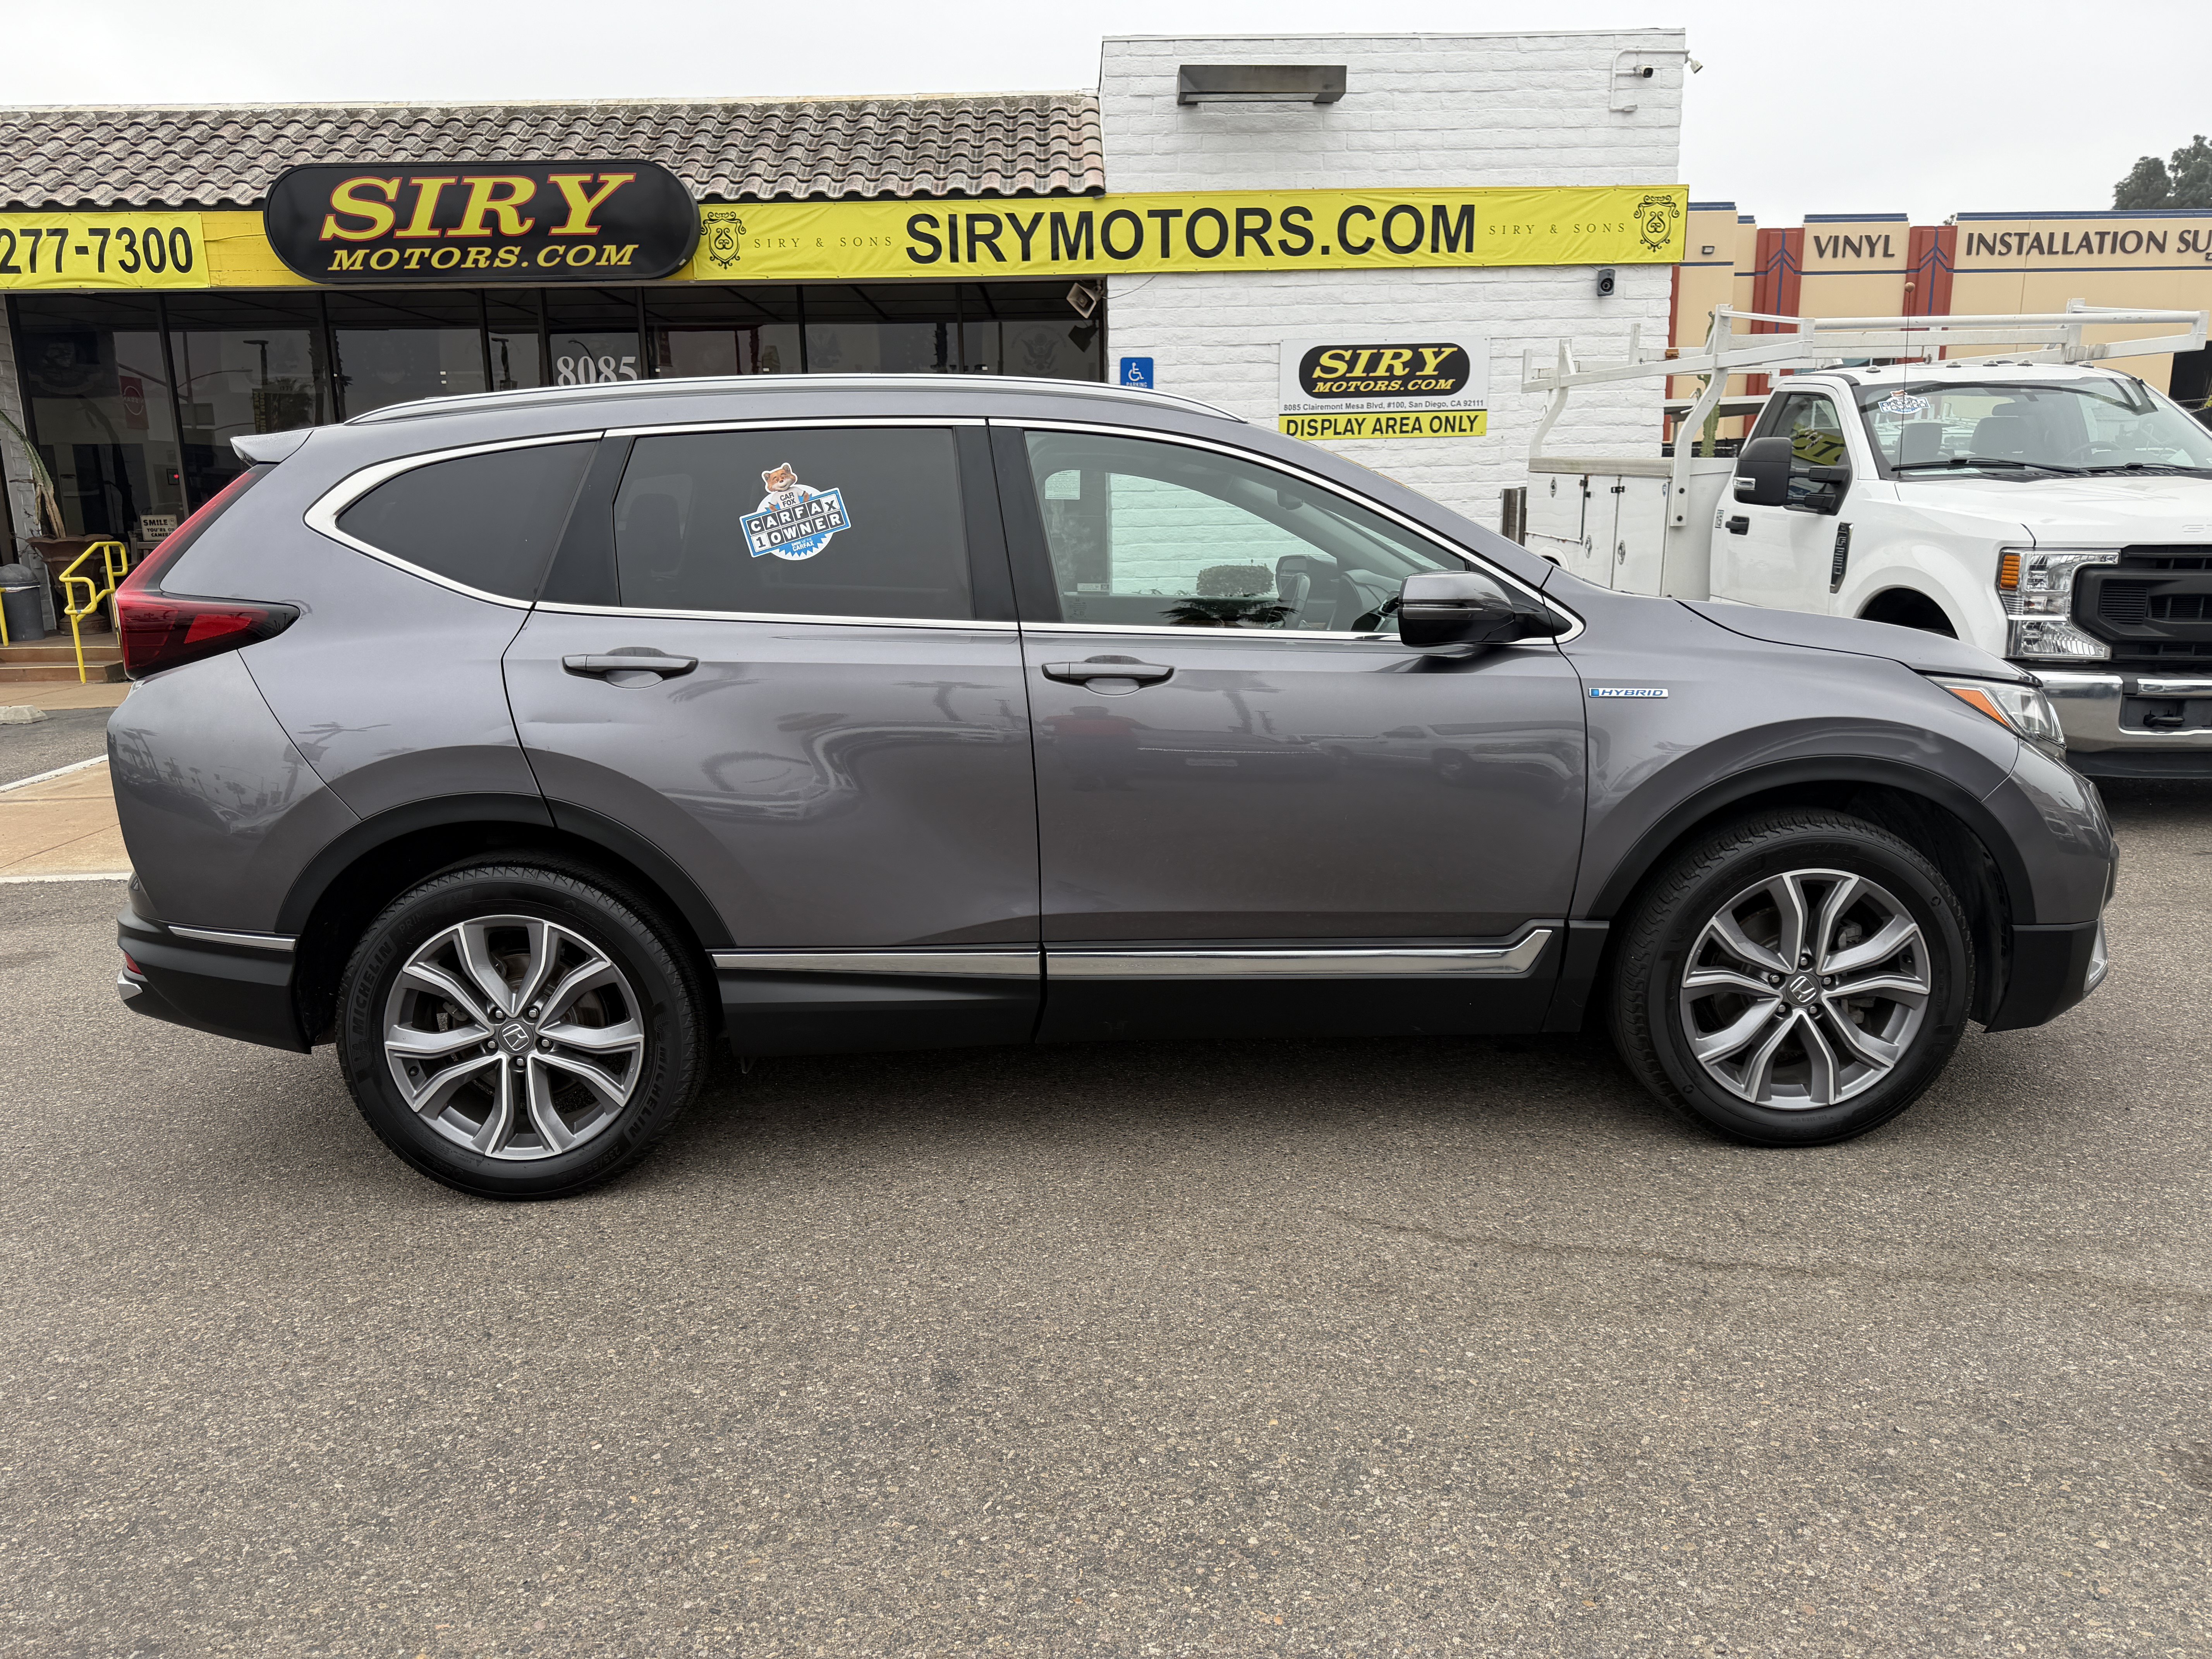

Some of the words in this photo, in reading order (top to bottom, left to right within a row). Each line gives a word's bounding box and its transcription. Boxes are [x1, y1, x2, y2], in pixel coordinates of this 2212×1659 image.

[319, 172, 636, 241] SIRY
[754, 238, 800, 249] SIRY
[816, 238, 824, 248] &
[840, 236, 892, 247] SONS
[906, 204, 1476, 264] SIRYMOTORS.COM
[1489, 224, 1536, 235] SIRY
[1549, 224, 1558, 234] &
[1574, 223, 1625, 233] SONS
[0, 227, 193, 275] 277-7300
[328, 244, 639, 270] MOTORS.COM
[1814, 234, 1895, 258] VINYL
[1966, 230, 2167, 256] INSTALLATION
[557, 356, 637, 386] 8085
[1312, 347, 1458, 378] SIRY
[1312, 379, 1456, 393] MOTORS.COM
[1425, 400, 1448, 409] Diego,
[1287, 418, 1367, 437] DISPLAY
[1371, 416, 1422, 435] AREA
[1429, 415, 1479, 433] ONLY
[780, 492, 795, 501] CAR
[782, 498, 796, 507] FOX
[750, 500, 837, 532] CARFAX
[756, 536, 766, 548] 1
[771, 514, 841, 544] OWNER
[792, 540, 814, 551] CARFAX
[352, 941, 392, 1036] MICHELIN
[628, 1046, 667, 1138] MICHELIN
